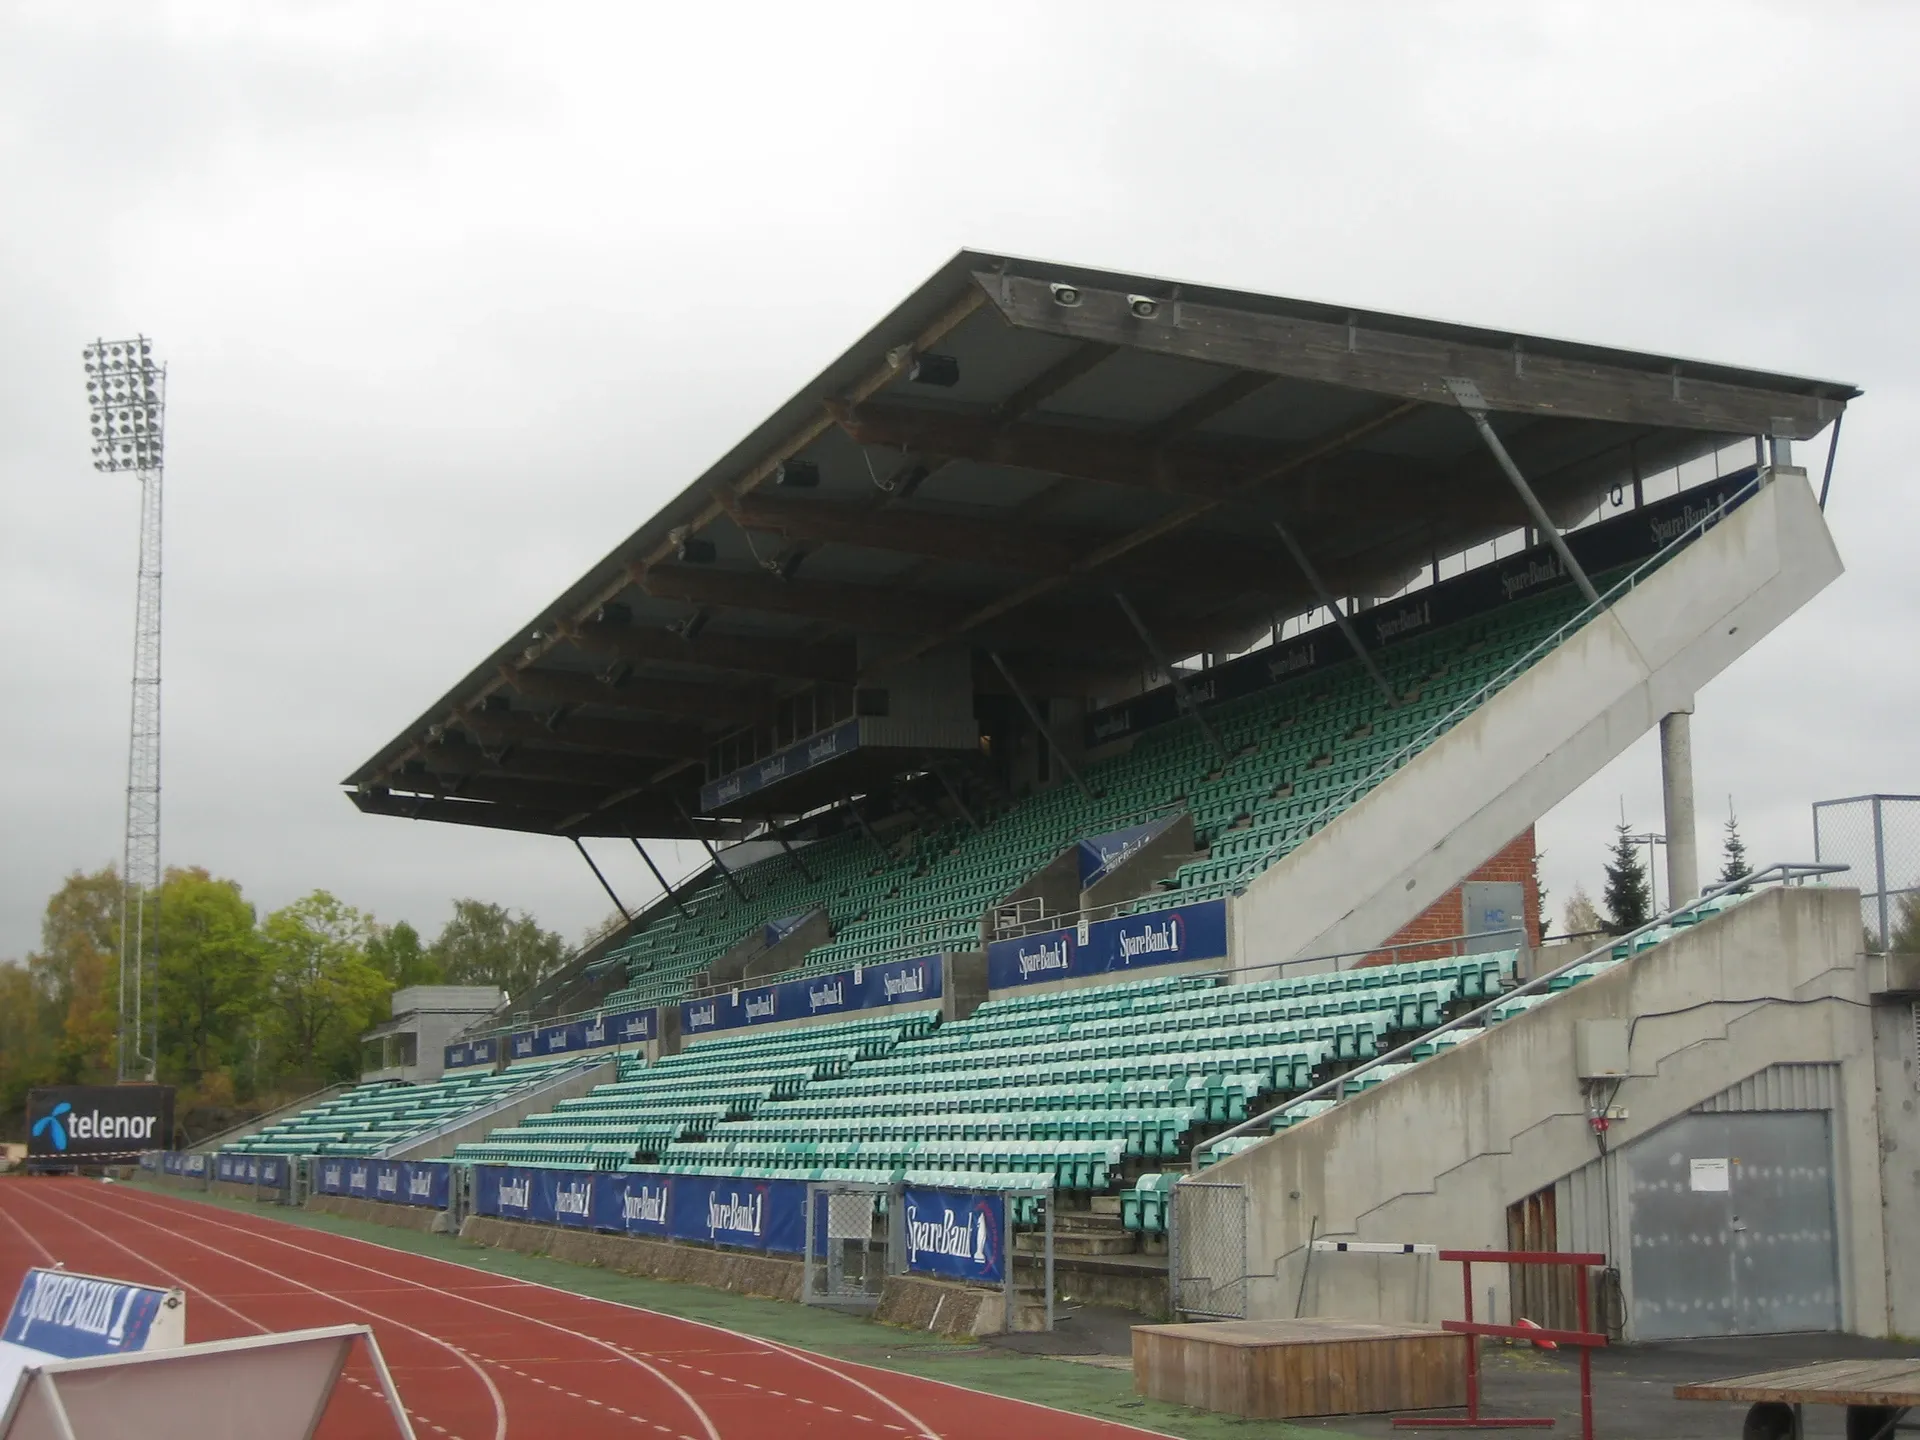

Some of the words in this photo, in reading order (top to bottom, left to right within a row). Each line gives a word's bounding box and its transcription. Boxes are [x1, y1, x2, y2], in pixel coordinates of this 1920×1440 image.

[1611, 484, 1623, 507] Q
[1484, 908, 1505, 922] HC
[1019, 942, 1061, 980] SpareBank
[1061, 940, 1069, 968] 1
[1120, 922, 1170, 964] SpareBank
[1170, 920, 1179, 951] 1
[67, 1109, 157, 1139] telenor
[707, 1191, 755, 1238] SpareBank
[754, 1193, 762, 1236] 1
[906, 1205, 973, 1263] SpareBank
[973, 1212, 986, 1263] 1
